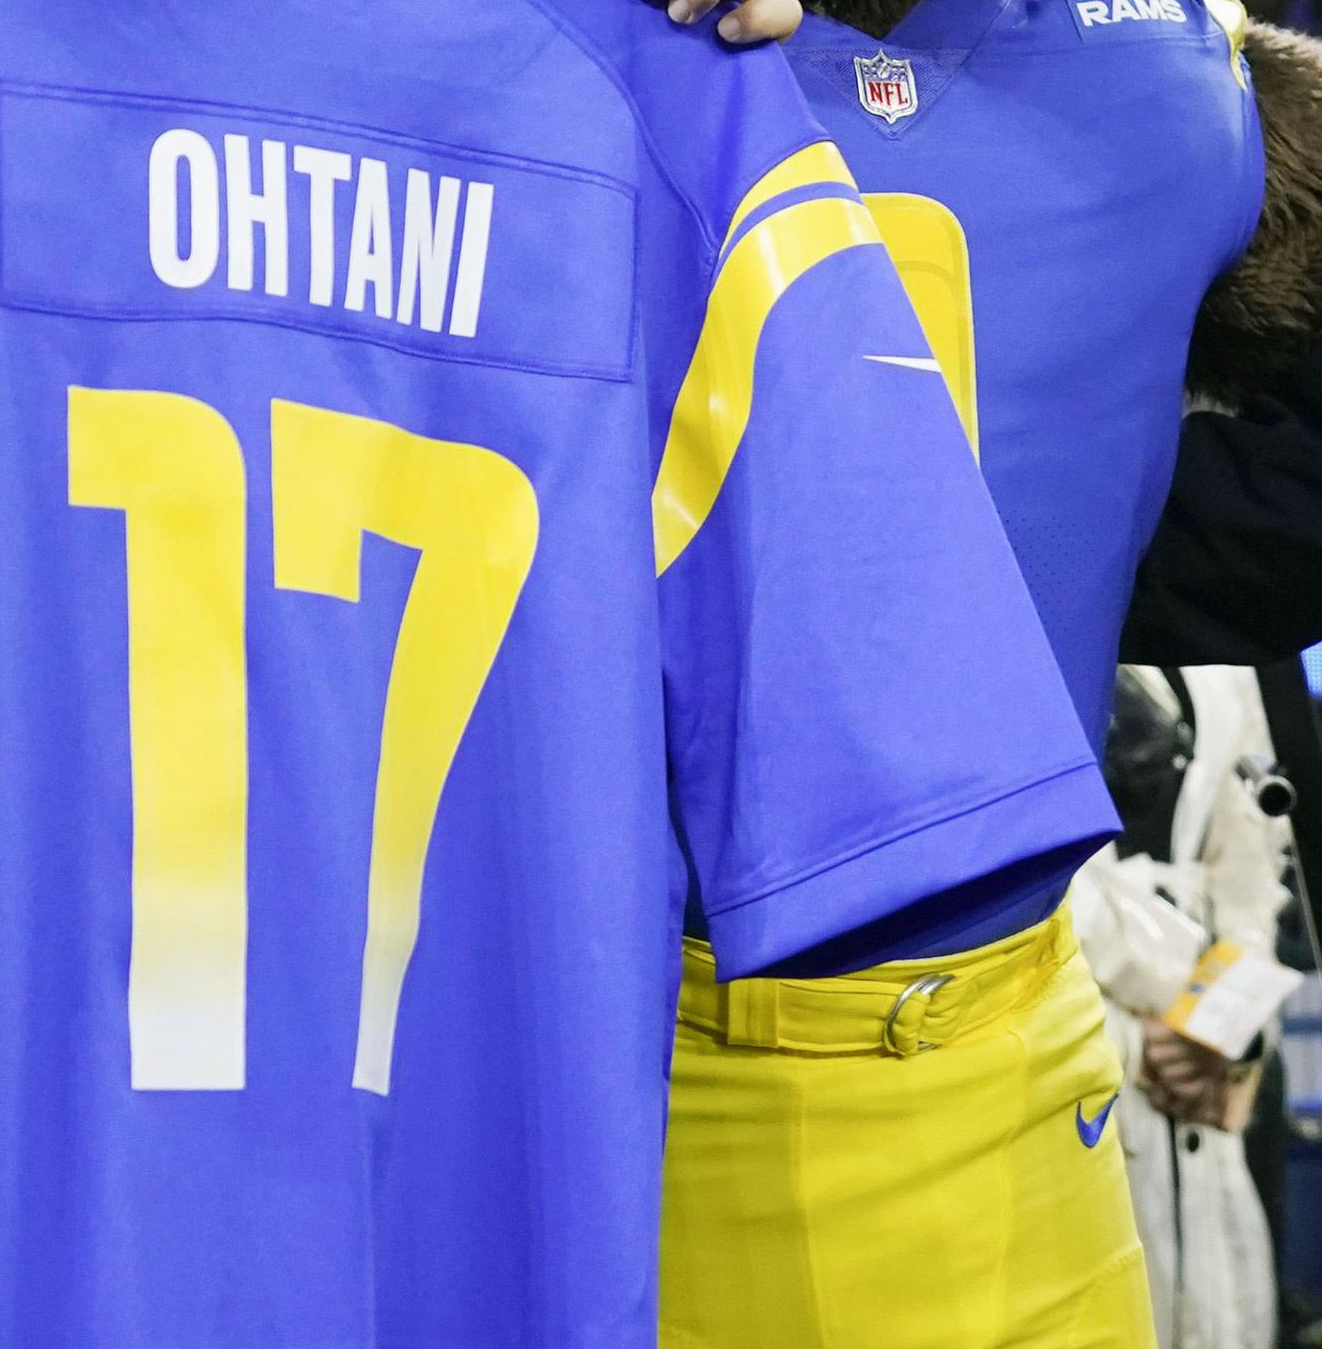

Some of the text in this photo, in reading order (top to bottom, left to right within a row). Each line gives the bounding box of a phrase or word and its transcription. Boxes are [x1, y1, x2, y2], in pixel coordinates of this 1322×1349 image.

[868, 80, 909, 106] NFL
[148, 128, 495, 338] OHTANI
[67, 384, 541, 1096] 17
